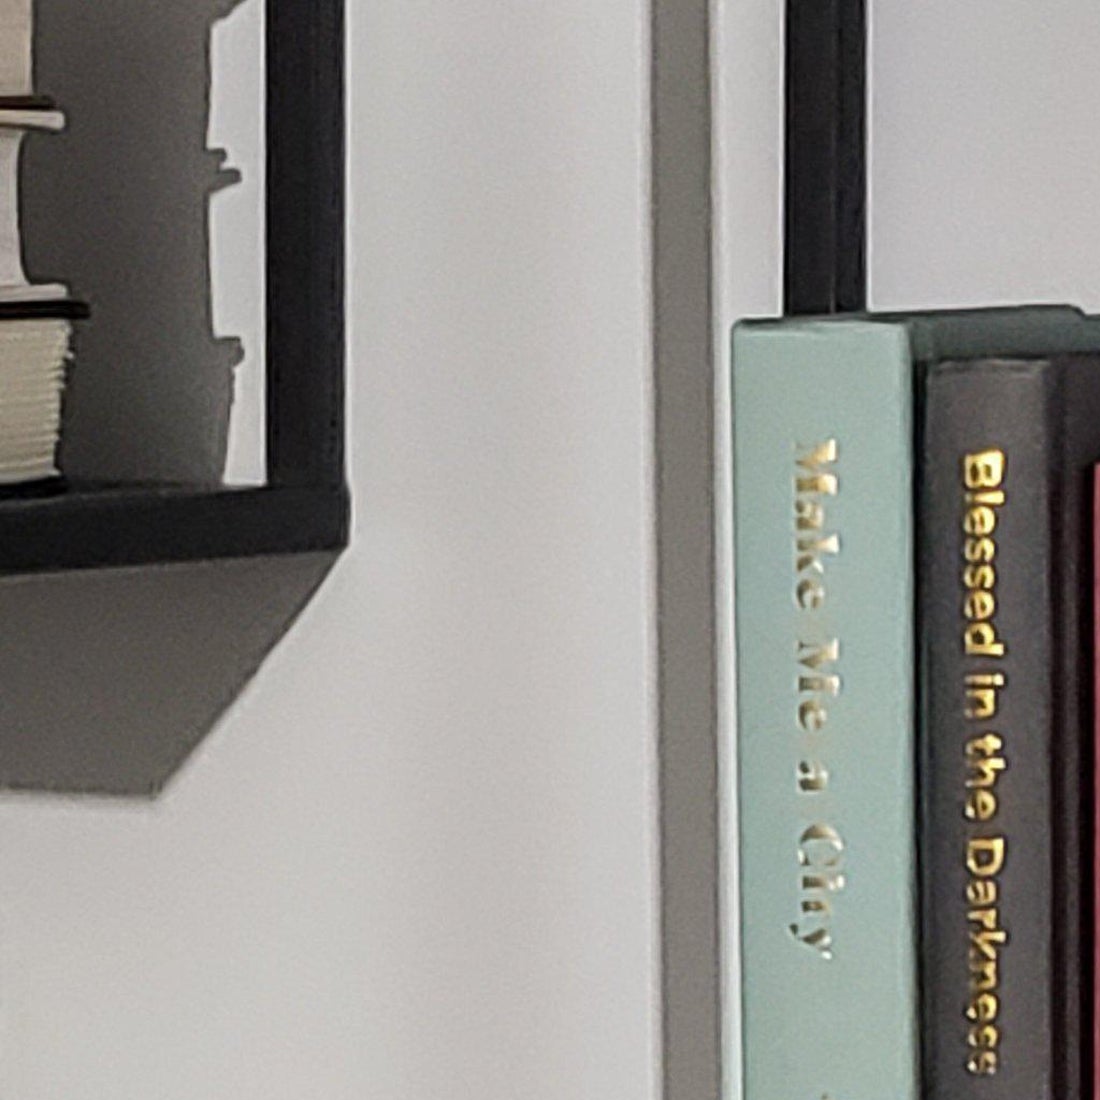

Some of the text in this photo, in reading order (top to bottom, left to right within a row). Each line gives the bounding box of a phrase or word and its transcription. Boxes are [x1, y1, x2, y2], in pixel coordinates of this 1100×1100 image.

[788, 437, 846, 961] Make Me a City
[963, 449, 1008, 1076] Blessed in the Darkness
